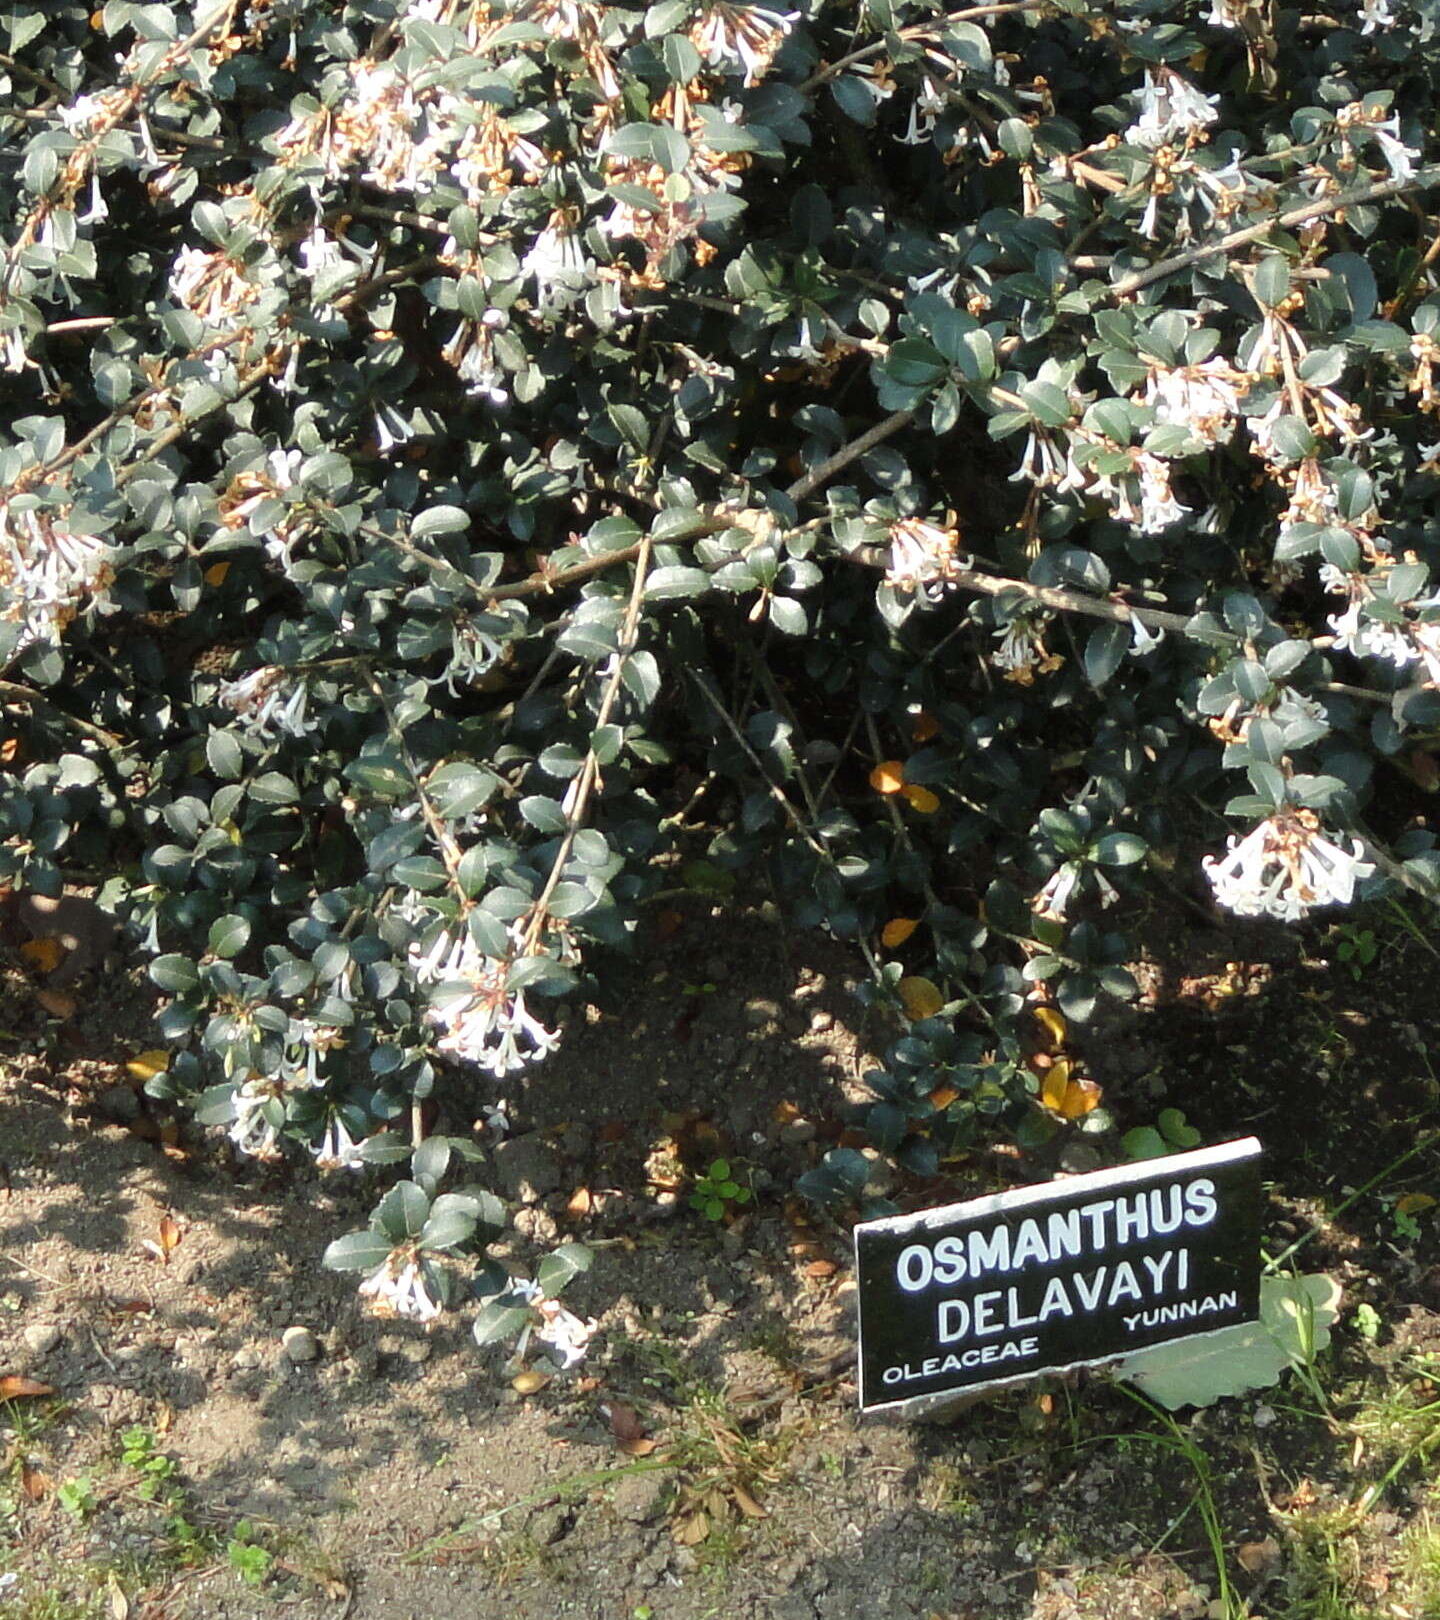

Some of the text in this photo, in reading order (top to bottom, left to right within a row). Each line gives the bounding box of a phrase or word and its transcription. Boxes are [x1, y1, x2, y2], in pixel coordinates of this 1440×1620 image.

[896, 1178, 1218, 1291] OSMANTHUS
[882, 1290, 1238, 1384] OLEACEAE YUNNAN
[938, 1248, 1189, 1344] DELAVAYI
